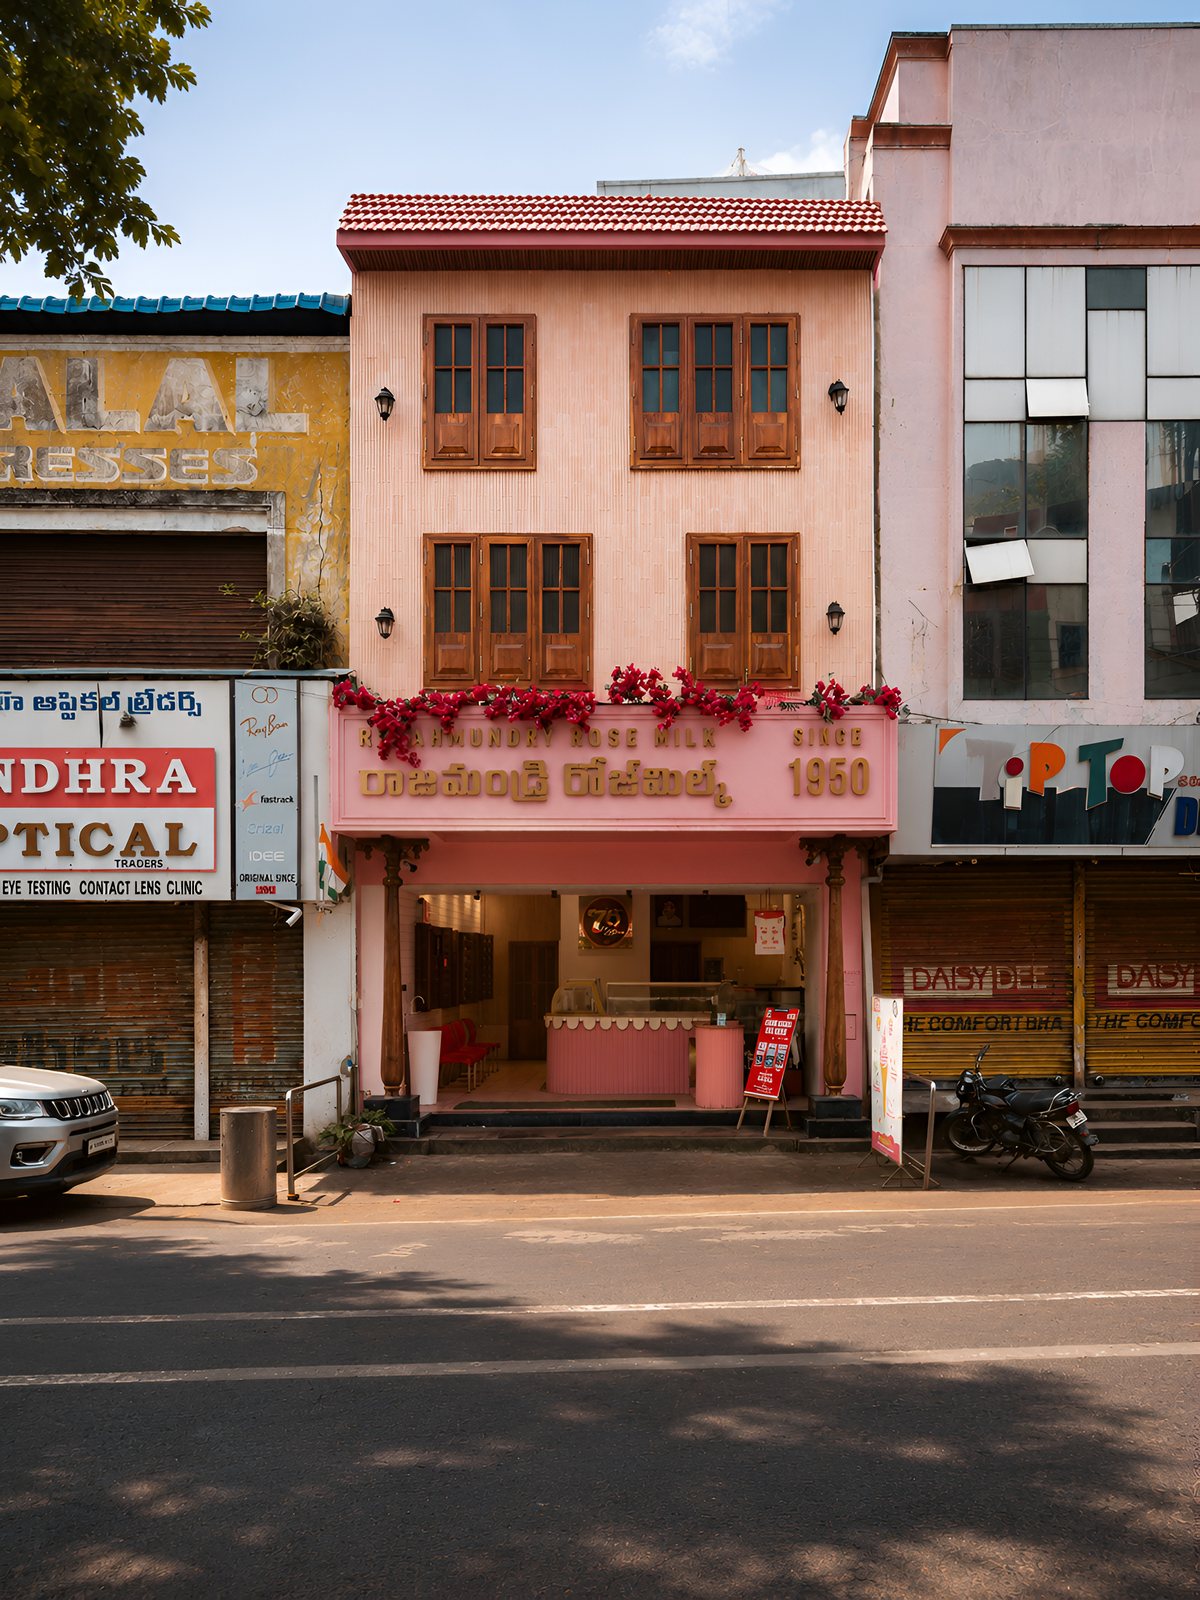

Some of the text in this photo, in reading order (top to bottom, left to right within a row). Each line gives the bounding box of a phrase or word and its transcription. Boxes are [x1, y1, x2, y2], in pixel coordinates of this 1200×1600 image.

[359, 727, 716, 747] RAHMUNDRY ROSE MILK
[793, 727, 862, 747] SINCE
[788, 757, 870, 796] 1950
[261, 795, 295, 804] fastrack
[0, 822, 198, 857] TICAL
[114, 859, 163, 868] TRADERS
[249, 850, 286, 861] IDEE
[2, 880, 203, 895] EYE TESTING CONTACT LENS CLINIC
[912, 966, 991, 991] DAISY
[1117, 965, 1192, 988] DAISY
